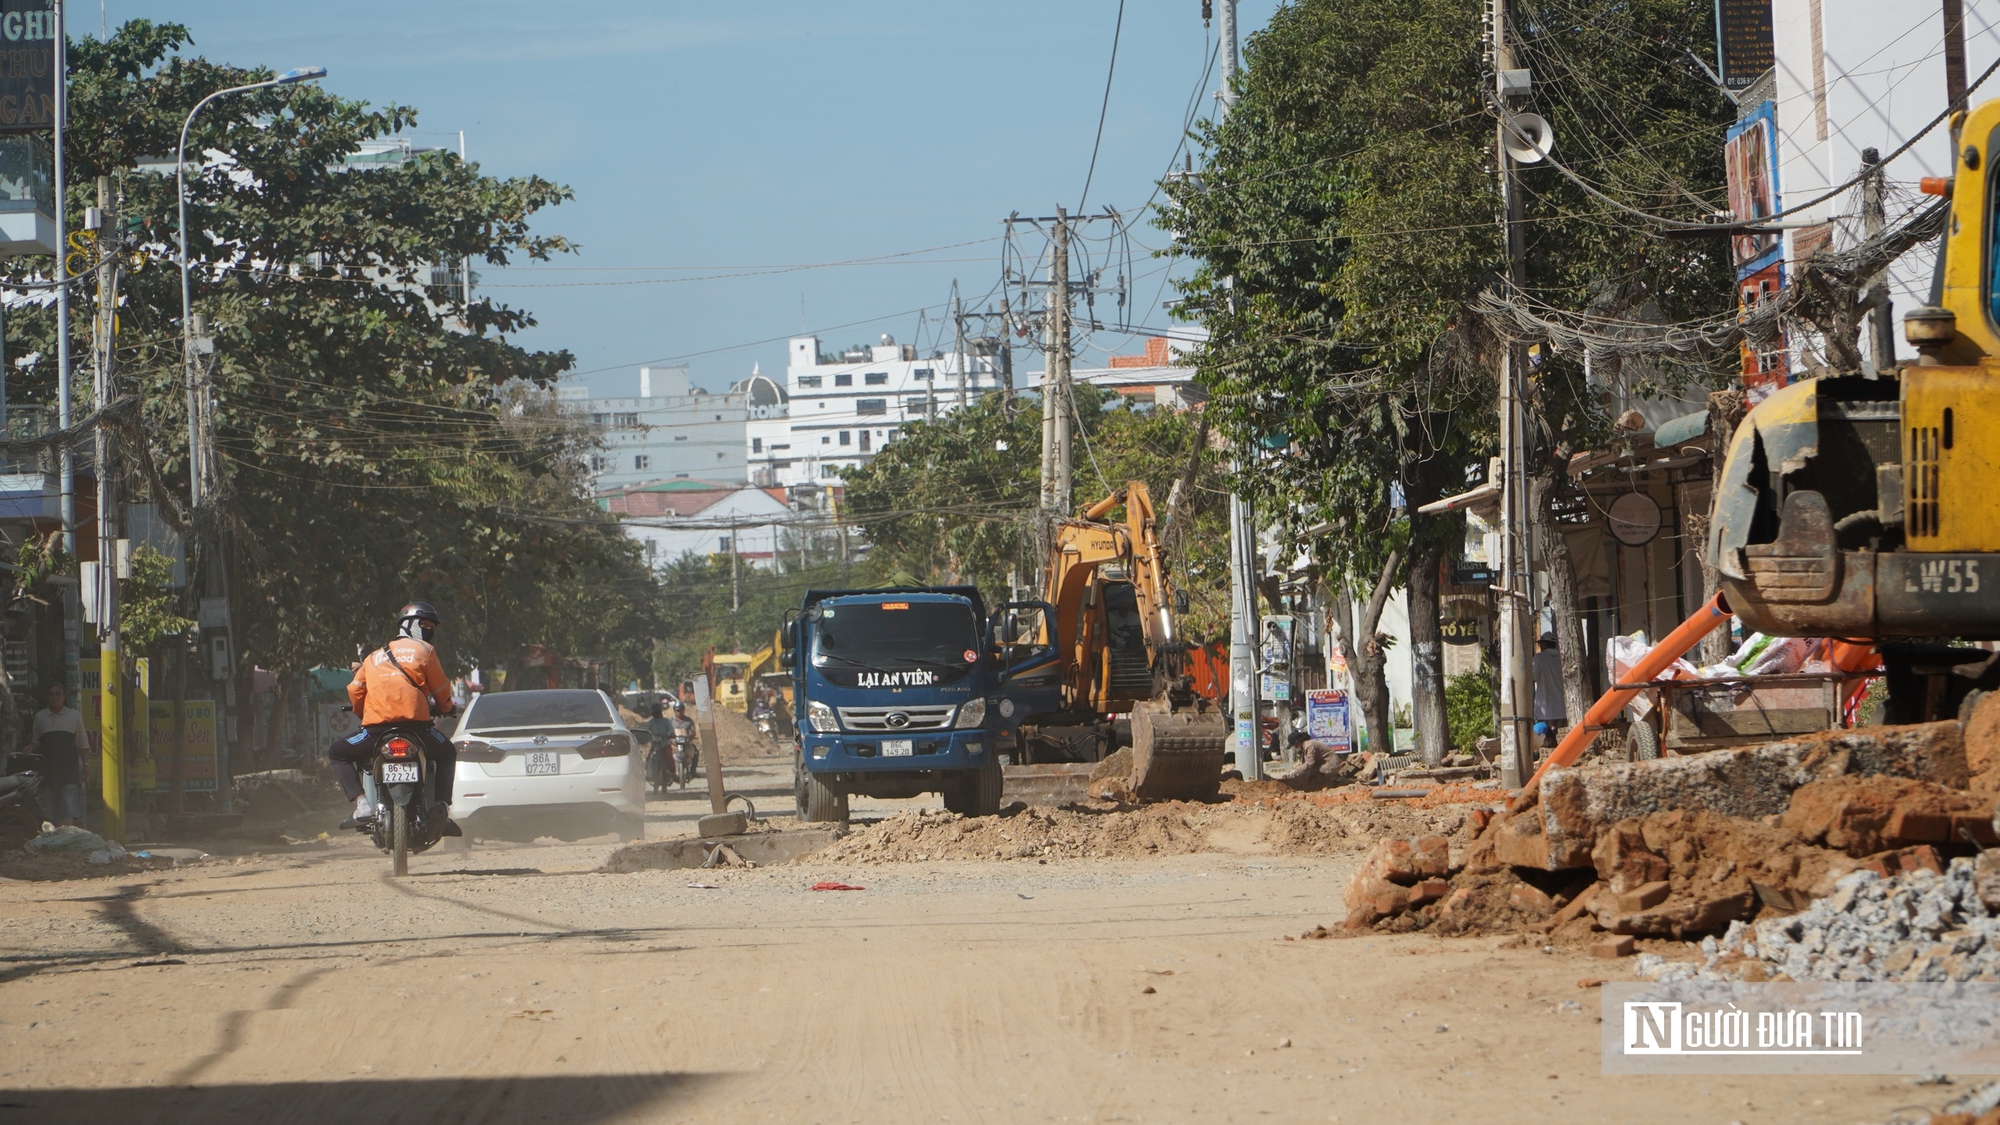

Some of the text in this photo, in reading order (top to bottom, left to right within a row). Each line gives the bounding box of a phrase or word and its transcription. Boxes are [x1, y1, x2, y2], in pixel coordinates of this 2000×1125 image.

[0, 1, 54, 41] GHỈ
[857, 668, 933, 689] LẠI AN VIÊN
[532, 753, 550, 763] 86A
